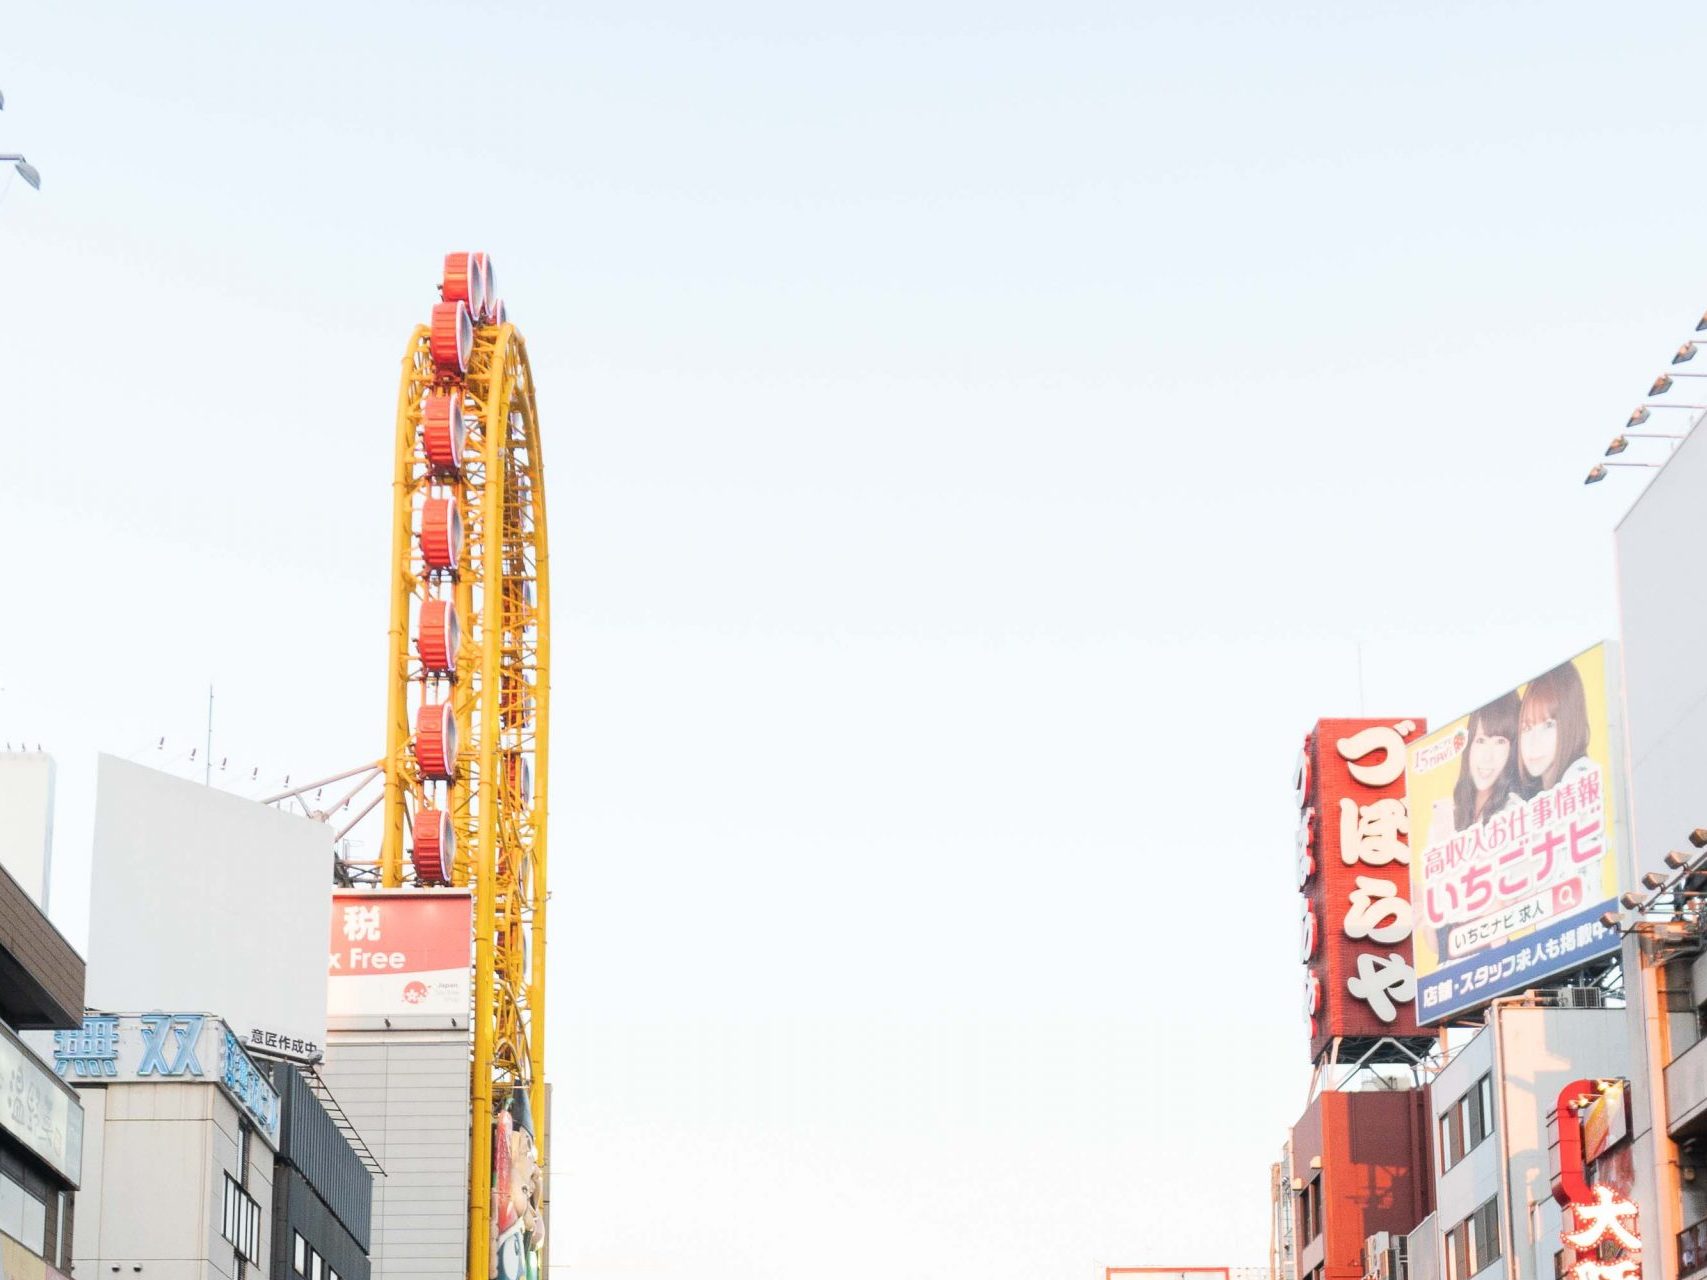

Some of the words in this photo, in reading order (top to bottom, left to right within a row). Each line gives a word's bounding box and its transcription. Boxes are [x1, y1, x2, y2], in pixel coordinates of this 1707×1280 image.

[1424, 771, 1600, 879] 高収入お仕事情報
[1427, 805, 1602, 923] いちごナビ
[350, 948, 406, 969] Free
[250, 1028, 318, 1053] 意匠作成中
